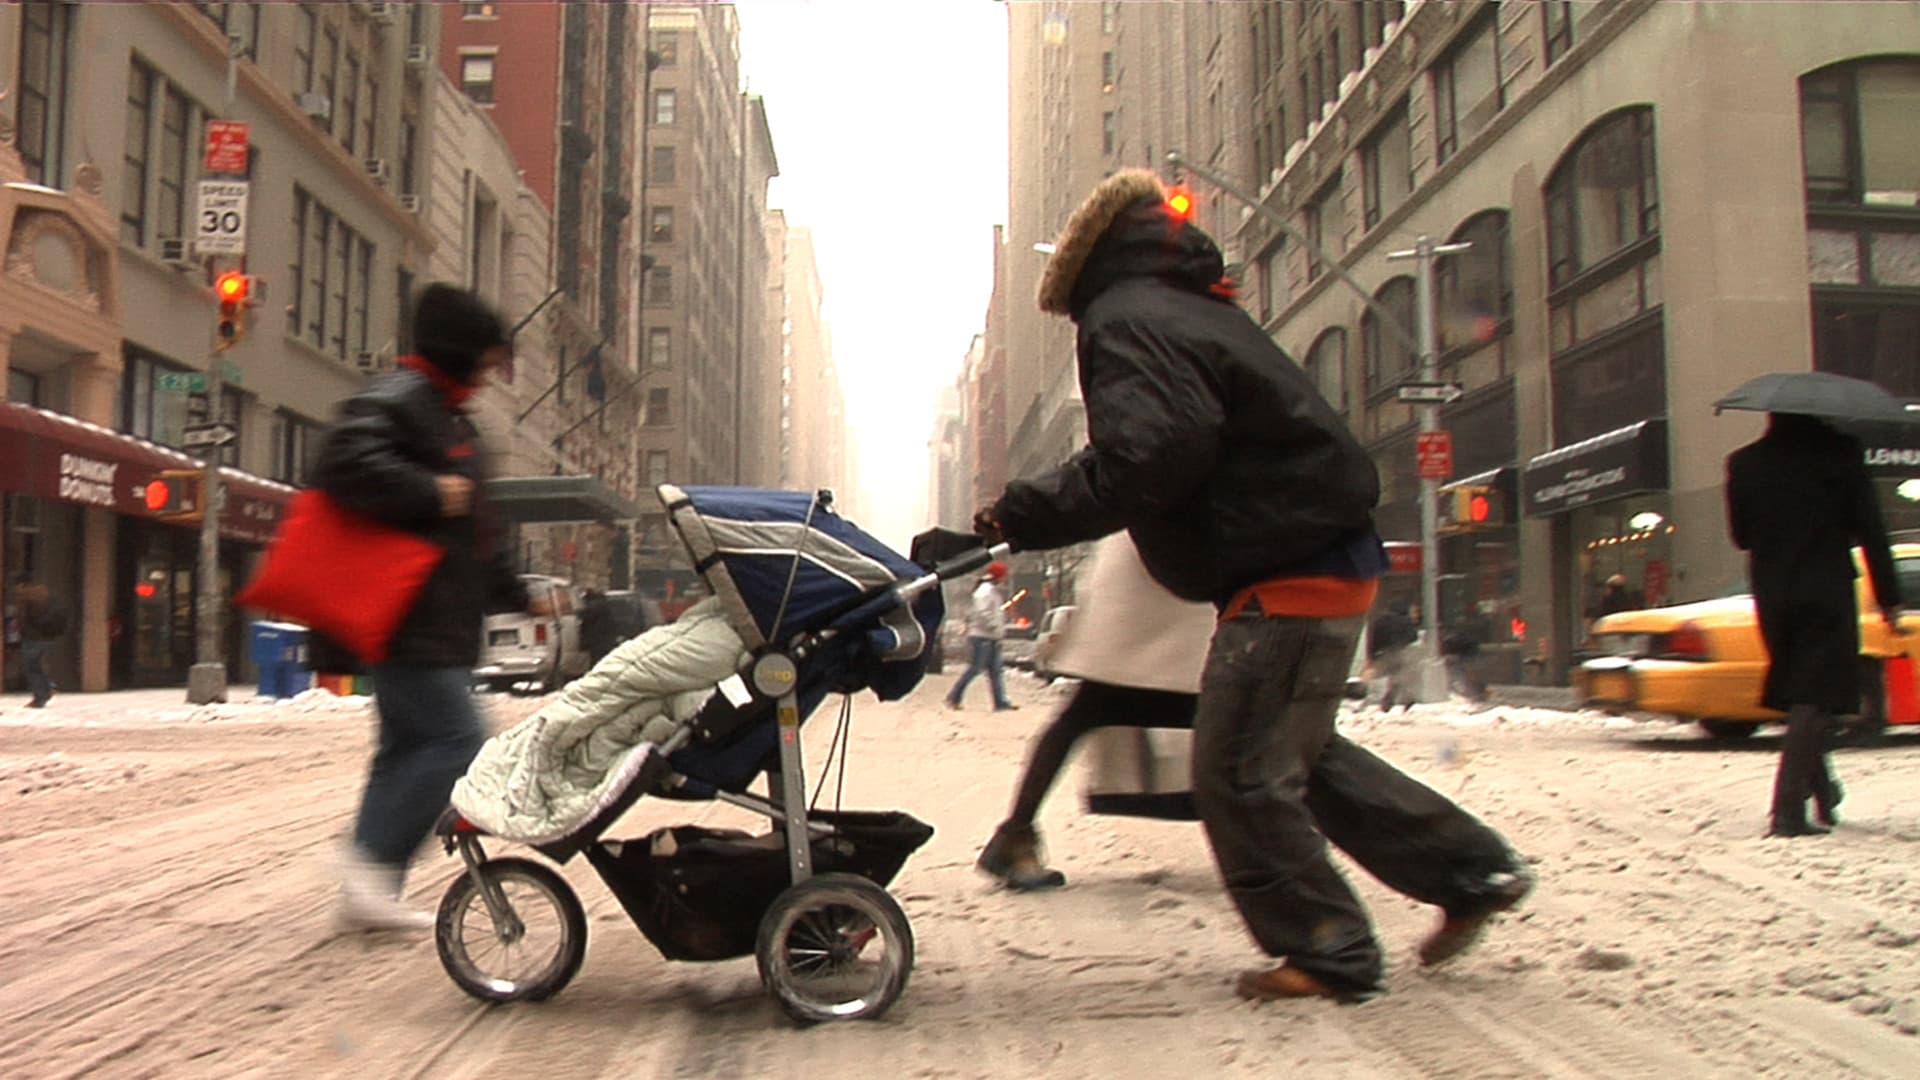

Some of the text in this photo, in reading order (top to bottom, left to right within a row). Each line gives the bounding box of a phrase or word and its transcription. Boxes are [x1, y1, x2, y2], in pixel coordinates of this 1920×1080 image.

[202, 184, 245, 197] SPEED
[205, 197, 239, 208] LIMIT
[200, 210, 241, 234] 30
[59, 475, 116, 506] DONUTS
